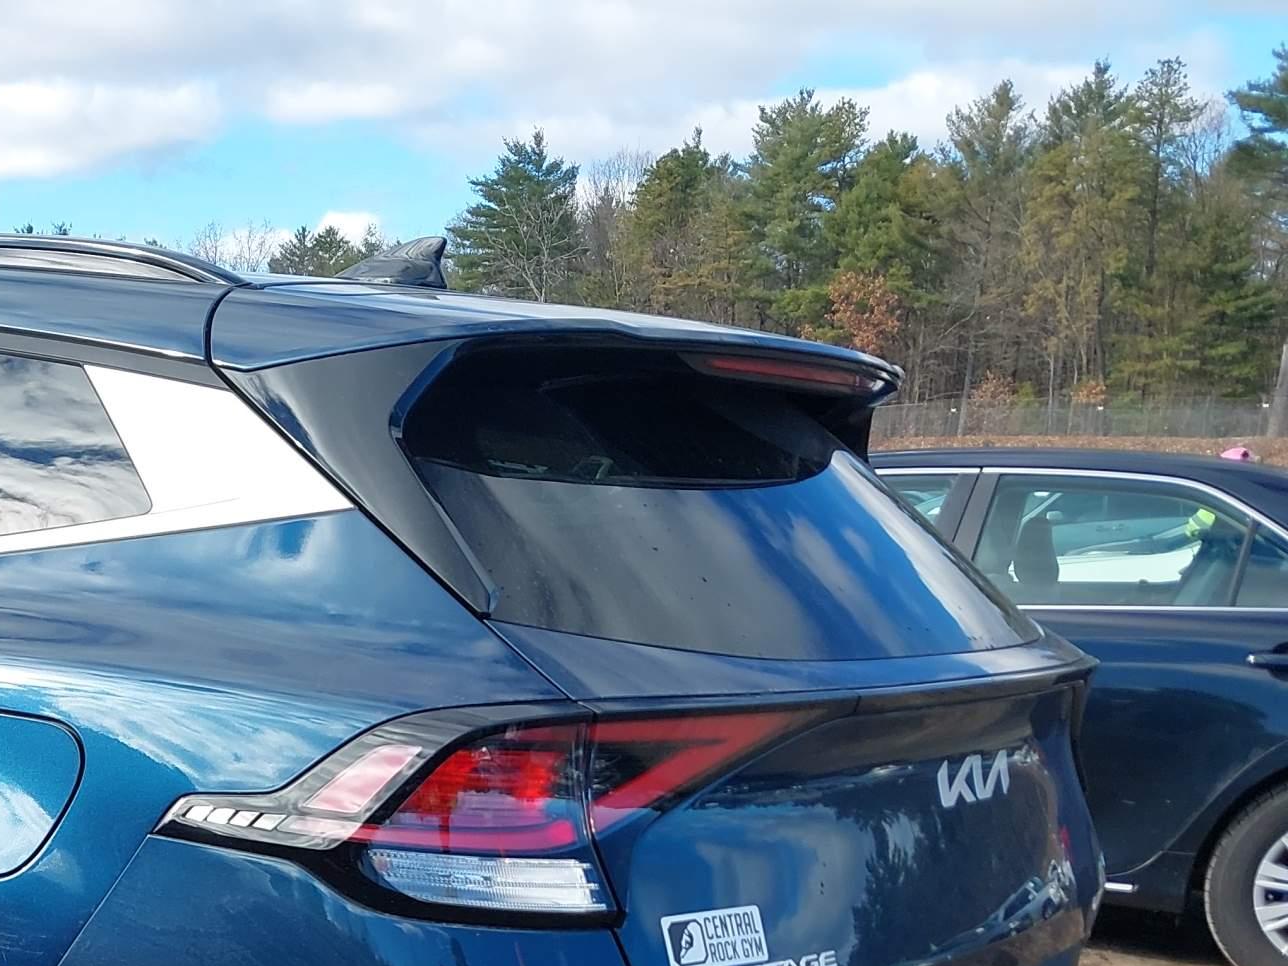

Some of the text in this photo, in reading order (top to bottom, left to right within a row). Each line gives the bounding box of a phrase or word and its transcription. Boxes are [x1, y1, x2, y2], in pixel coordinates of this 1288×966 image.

[937, 749, 1010, 808] KIA
[703, 911, 760, 940] CENTRAL
[708, 936, 765, 963] ROCK GYM
